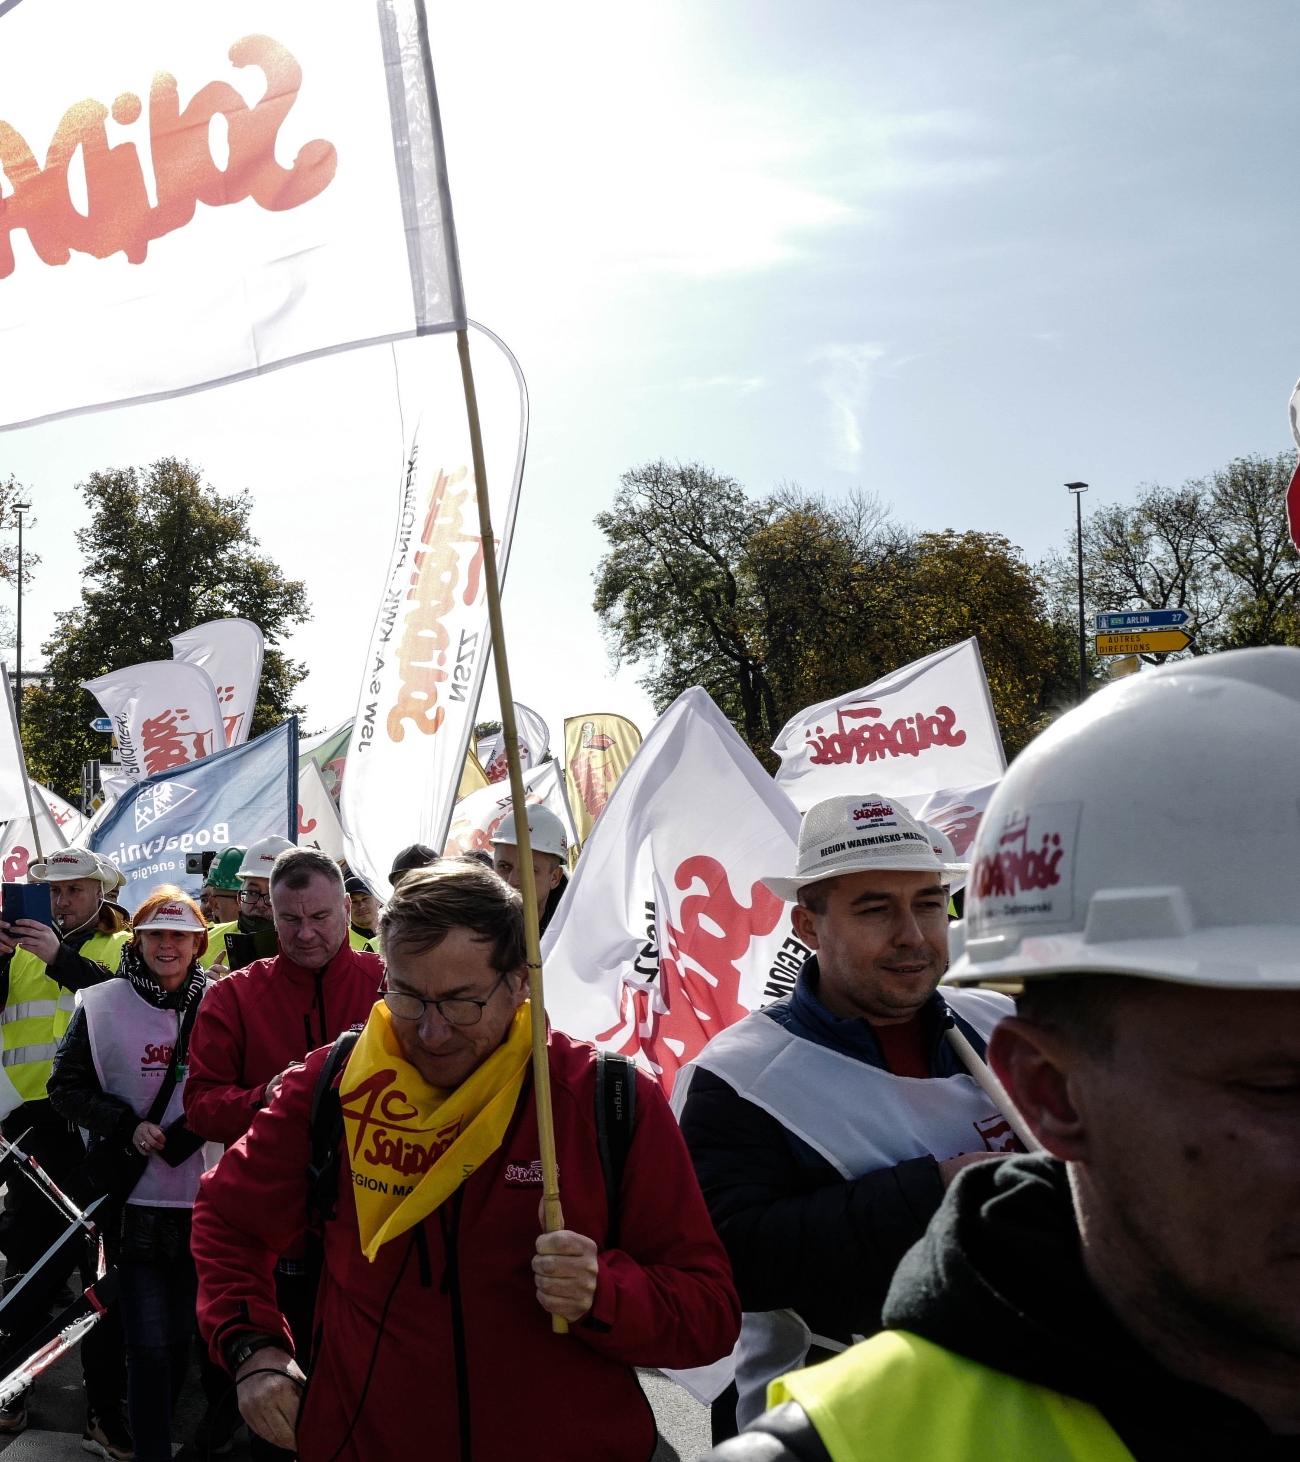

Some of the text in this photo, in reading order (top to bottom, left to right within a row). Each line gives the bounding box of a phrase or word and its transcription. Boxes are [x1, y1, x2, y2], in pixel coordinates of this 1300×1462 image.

[1126, 615, 1150, 624] ARLON
[1172, 613, 1182, 622] 27
[1108, 634, 1141, 643] AUTRES
[1099, 643, 1151, 654] DIRECTIONS
[820, 840, 847, 858] REGION
[614, 1079, 624, 1121] Targus
[351, 1171, 389, 1194] EGION
